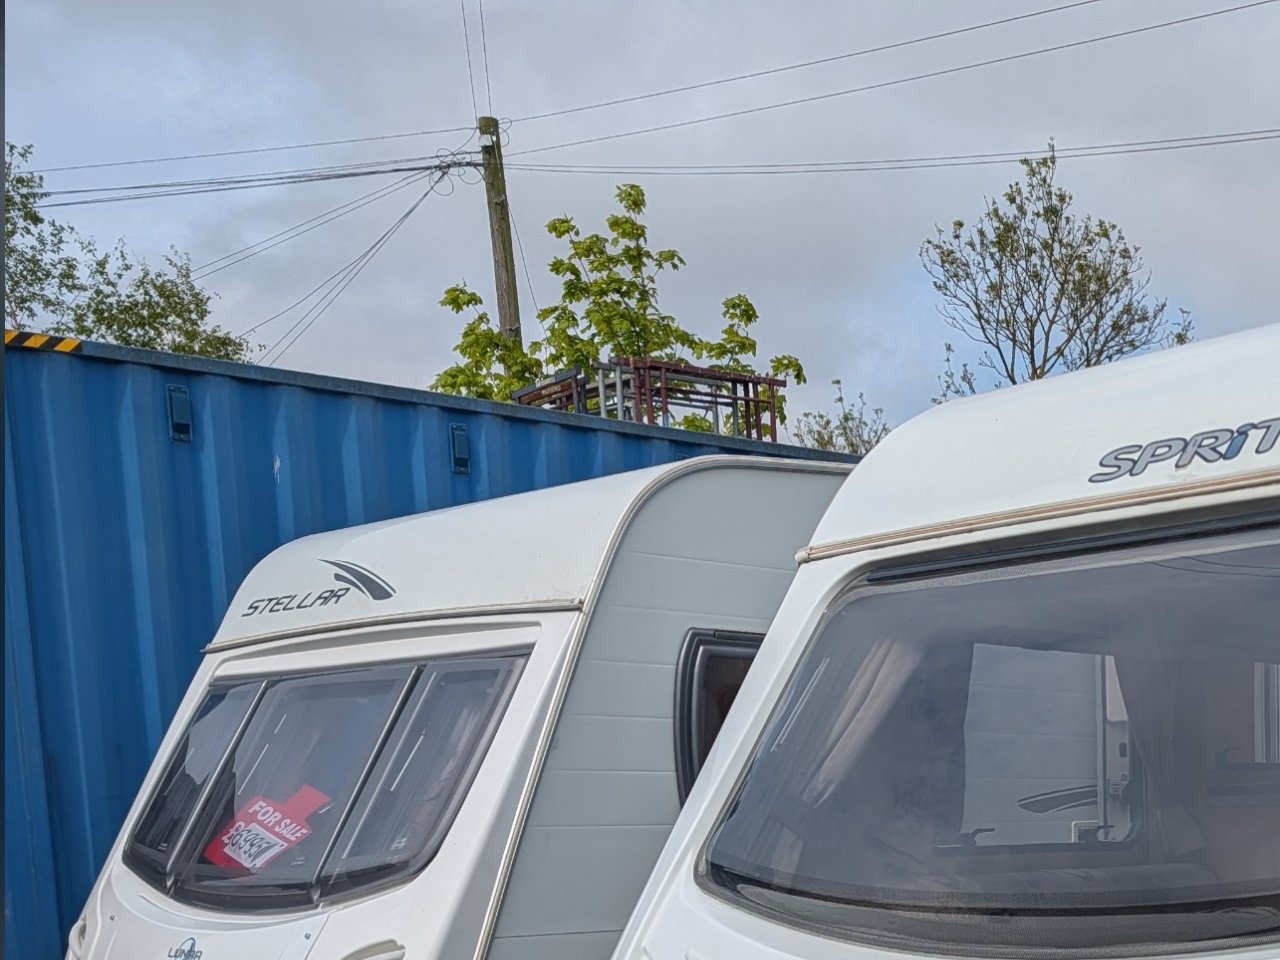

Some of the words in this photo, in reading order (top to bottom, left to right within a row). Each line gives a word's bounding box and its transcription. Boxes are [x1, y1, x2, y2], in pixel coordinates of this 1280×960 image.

[241, 587, 351, 617] STELLAR
[248, 800, 282, 827] FOR
[274, 818, 309, 841] SALE
[167, 947, 203, 960] LUNAR
